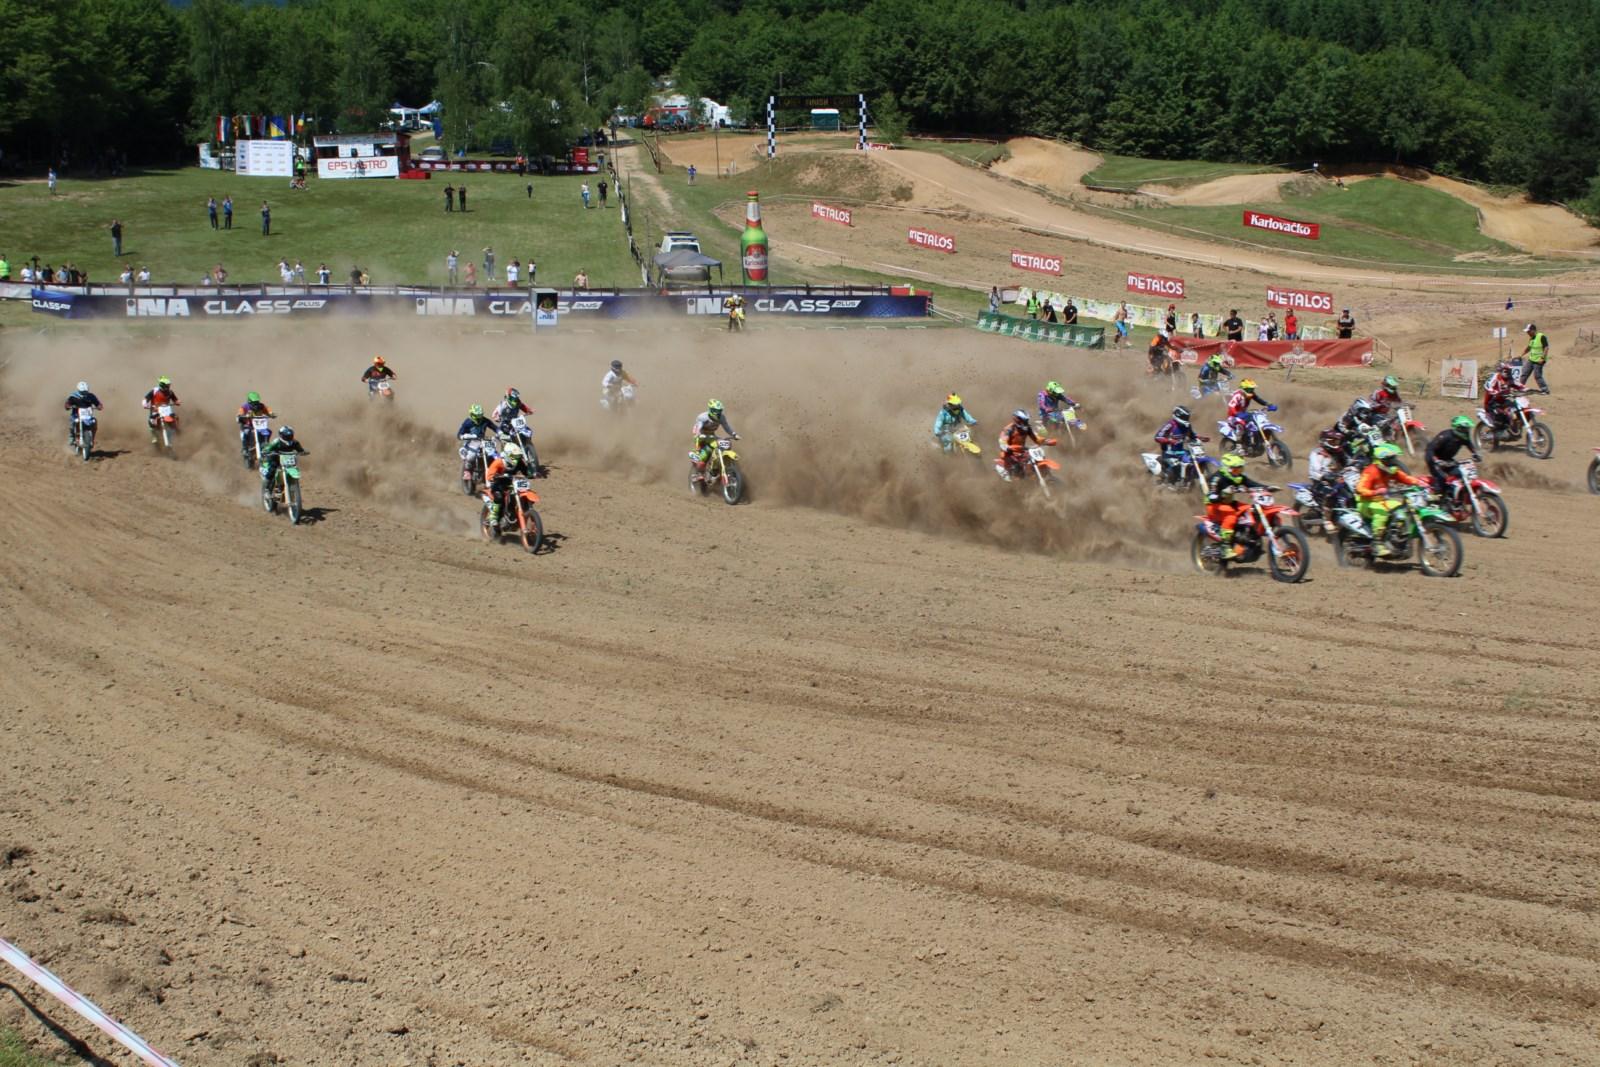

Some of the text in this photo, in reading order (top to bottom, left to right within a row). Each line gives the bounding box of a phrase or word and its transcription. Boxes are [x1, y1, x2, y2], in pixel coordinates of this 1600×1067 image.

[328, 161, 348, 170] EPS
[813, 204, 850, 223] METALOS
[1250, 215, 1311, 235] Karlovačko
[909, 230, 953, 249] METALOS
[1012, 254, 1060, 271] METALOS
[1127, 275, 1183, 294] METALOS
[32, 299, 60, 311] CLASS
[203, 300, 291, 314] CLASS
[488, 301, 572, 314] CLAS
[754, 299, 831, 312] CLASS
[1267, 290, 1331, 309] METALOS
